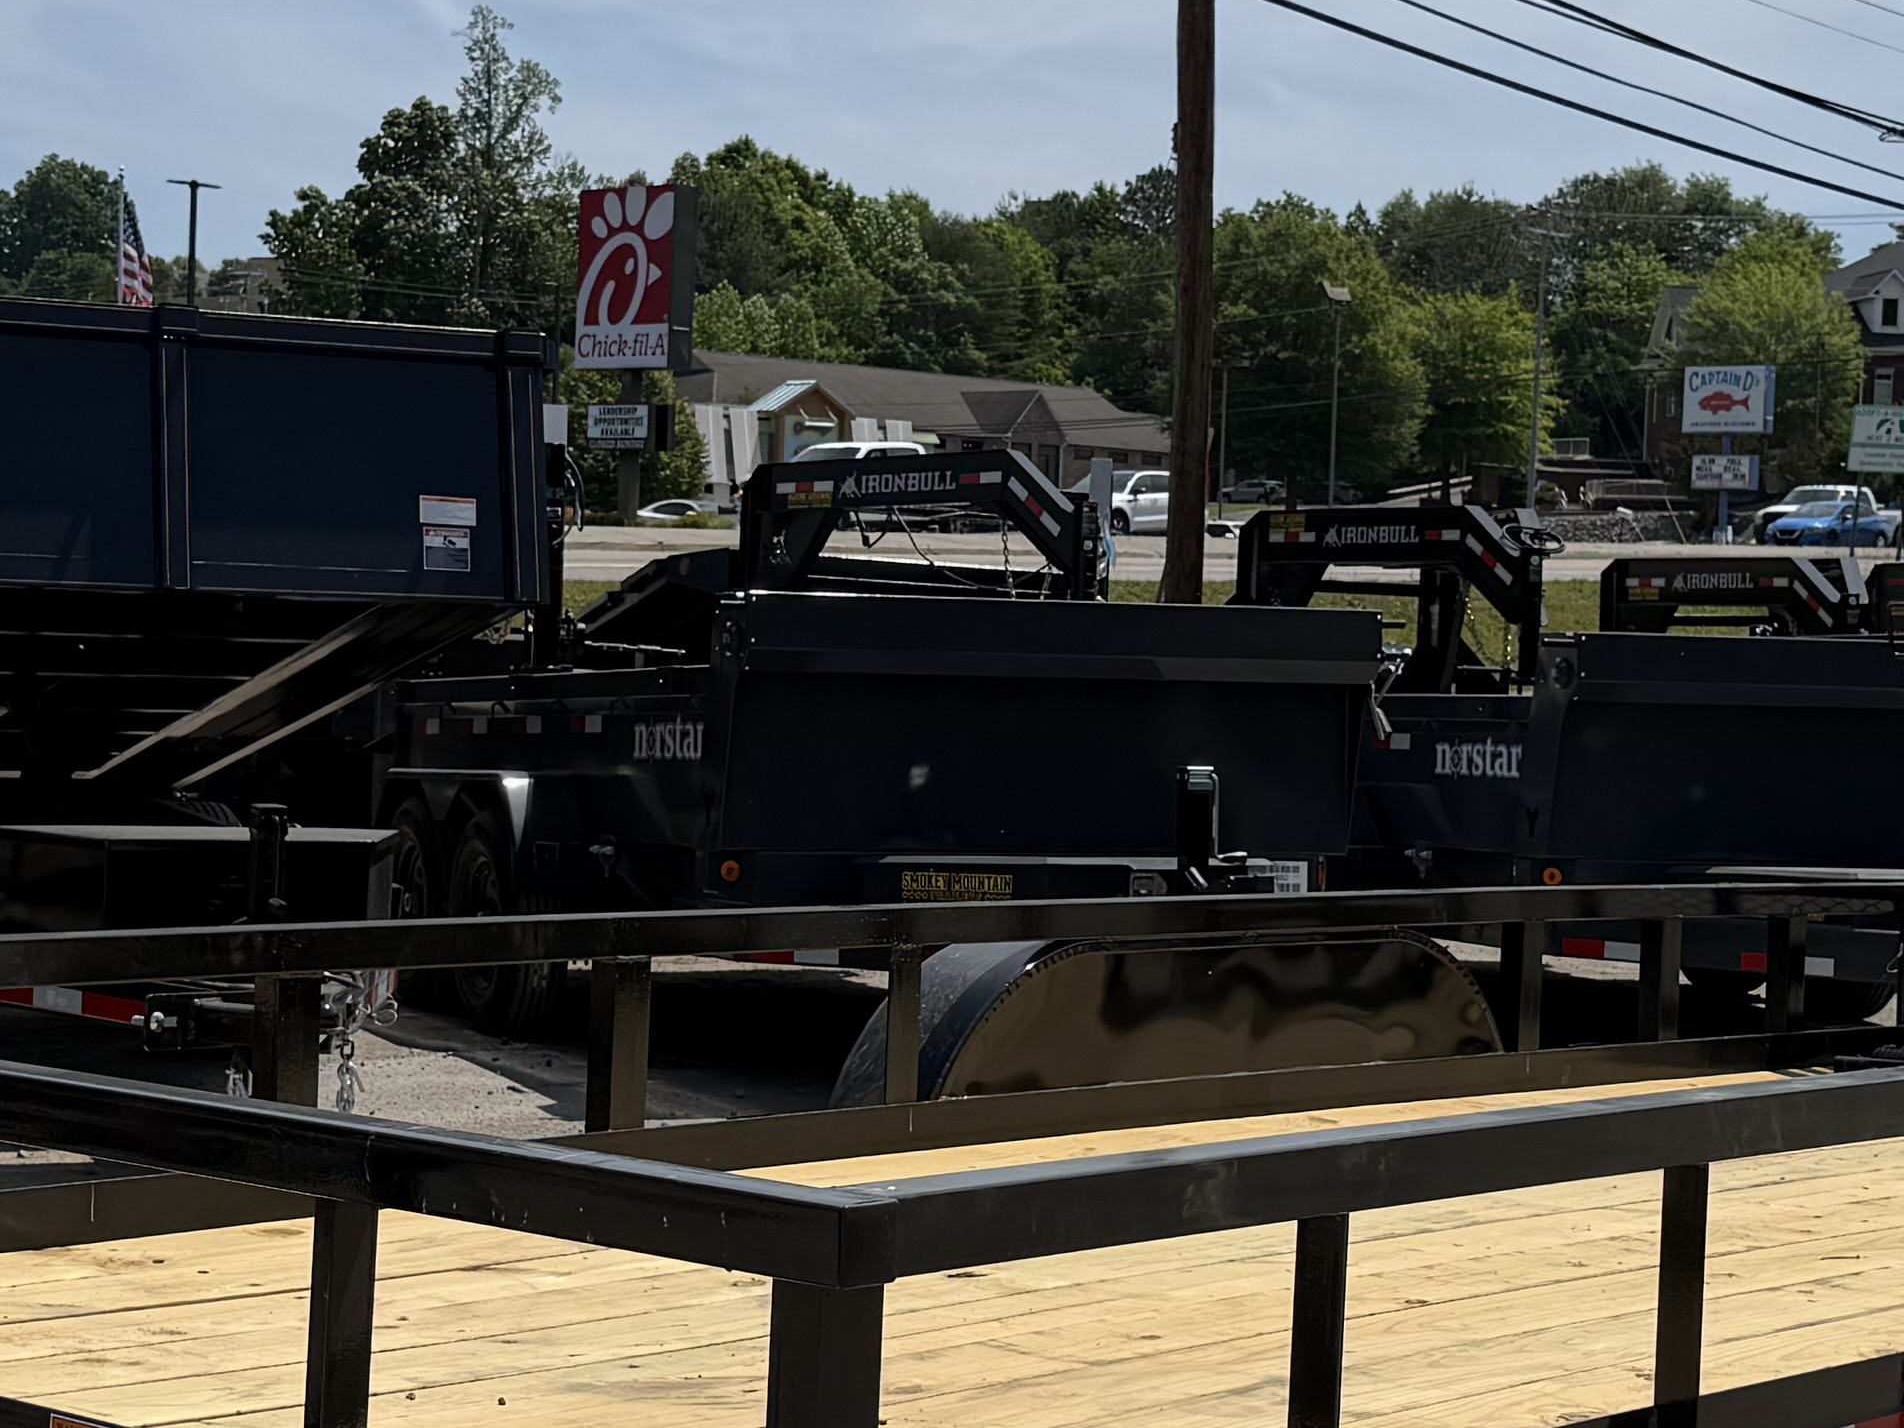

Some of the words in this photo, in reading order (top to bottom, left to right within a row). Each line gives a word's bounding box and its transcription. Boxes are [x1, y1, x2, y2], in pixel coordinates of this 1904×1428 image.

[577, 333, 667, 358] Chick-fil-A
[861, 471, 956, 494] IRONBULL
[1341, 525, 1419, 544] IRONBULL
[1687, 573, 1754, 589] IRONBULL
[902, 872, 948, 891] SMOKEY
[950, 874, 1013, 893] MOUNTAIN
